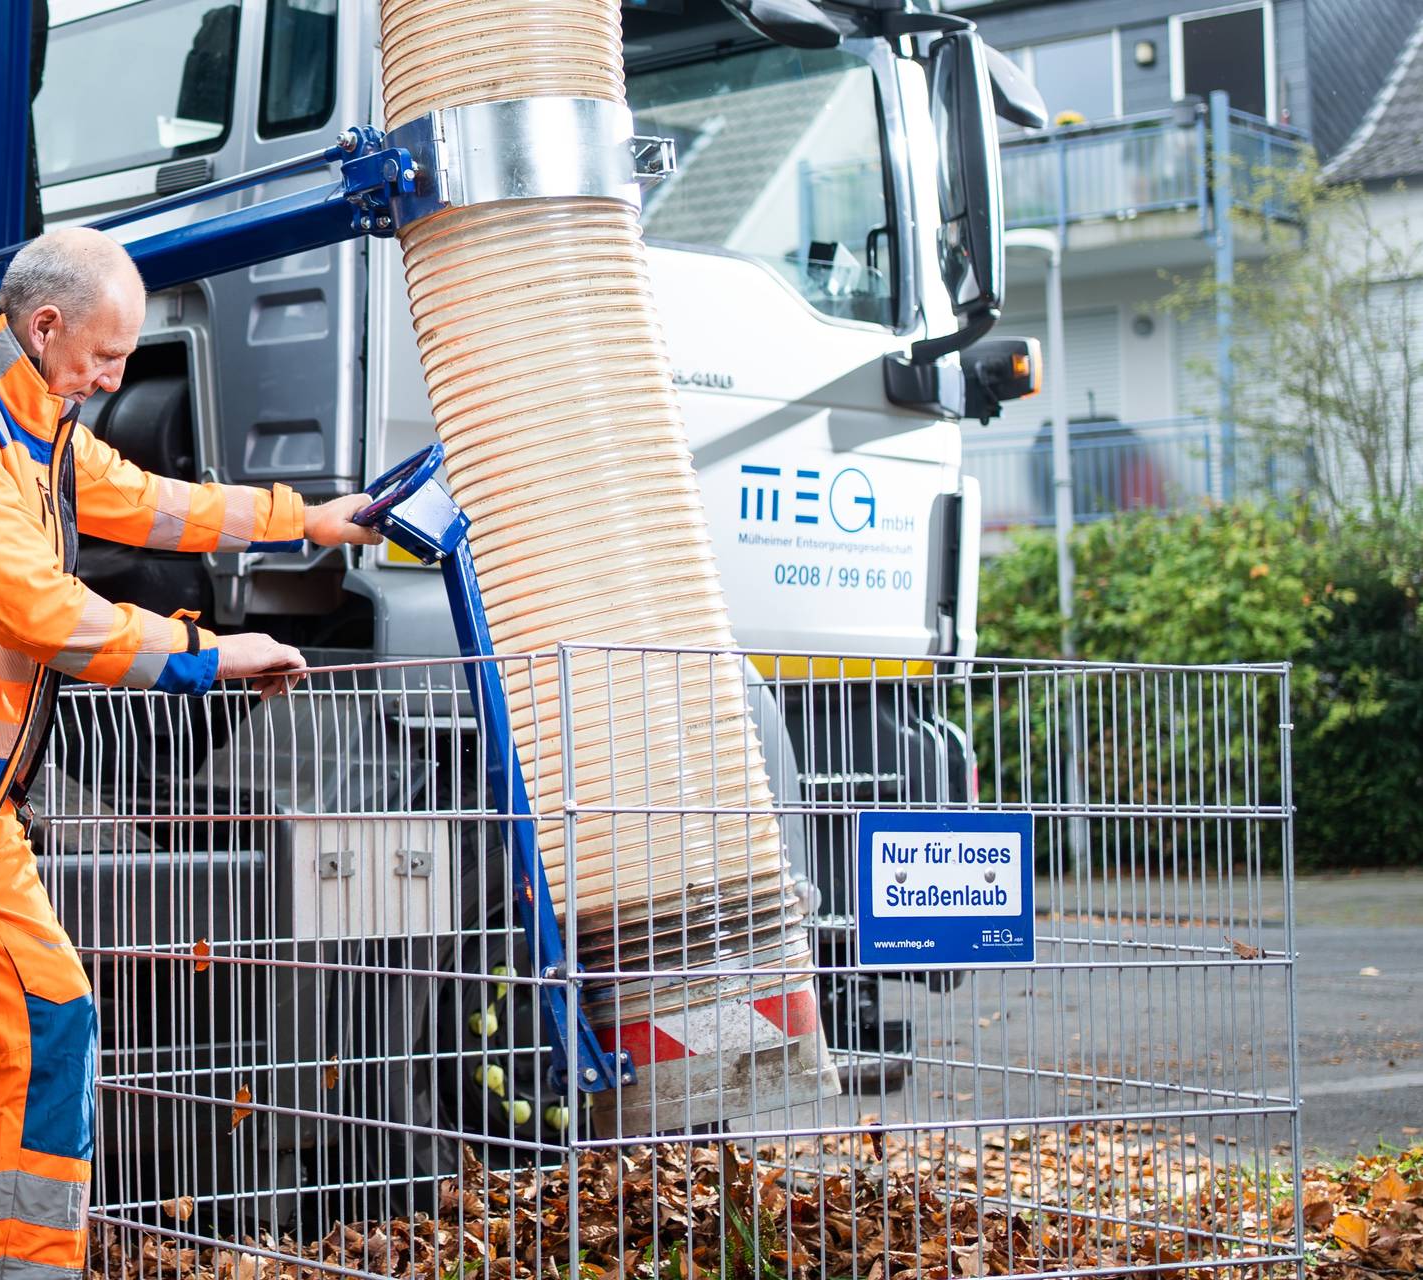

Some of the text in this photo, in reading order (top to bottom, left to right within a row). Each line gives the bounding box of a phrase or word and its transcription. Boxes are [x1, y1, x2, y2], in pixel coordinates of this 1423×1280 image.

[881, 516, 915, 532] mbH
[738, 532, 793, 546] Mülheimer
[774, 563, 912, 590] 0208 / 99 66 00
[882, 842, 1011, 864] Nur für loses
[886, 885, 1007, 906] Straßenlaub
[874, 939, 935, 949] www.mheg.de
